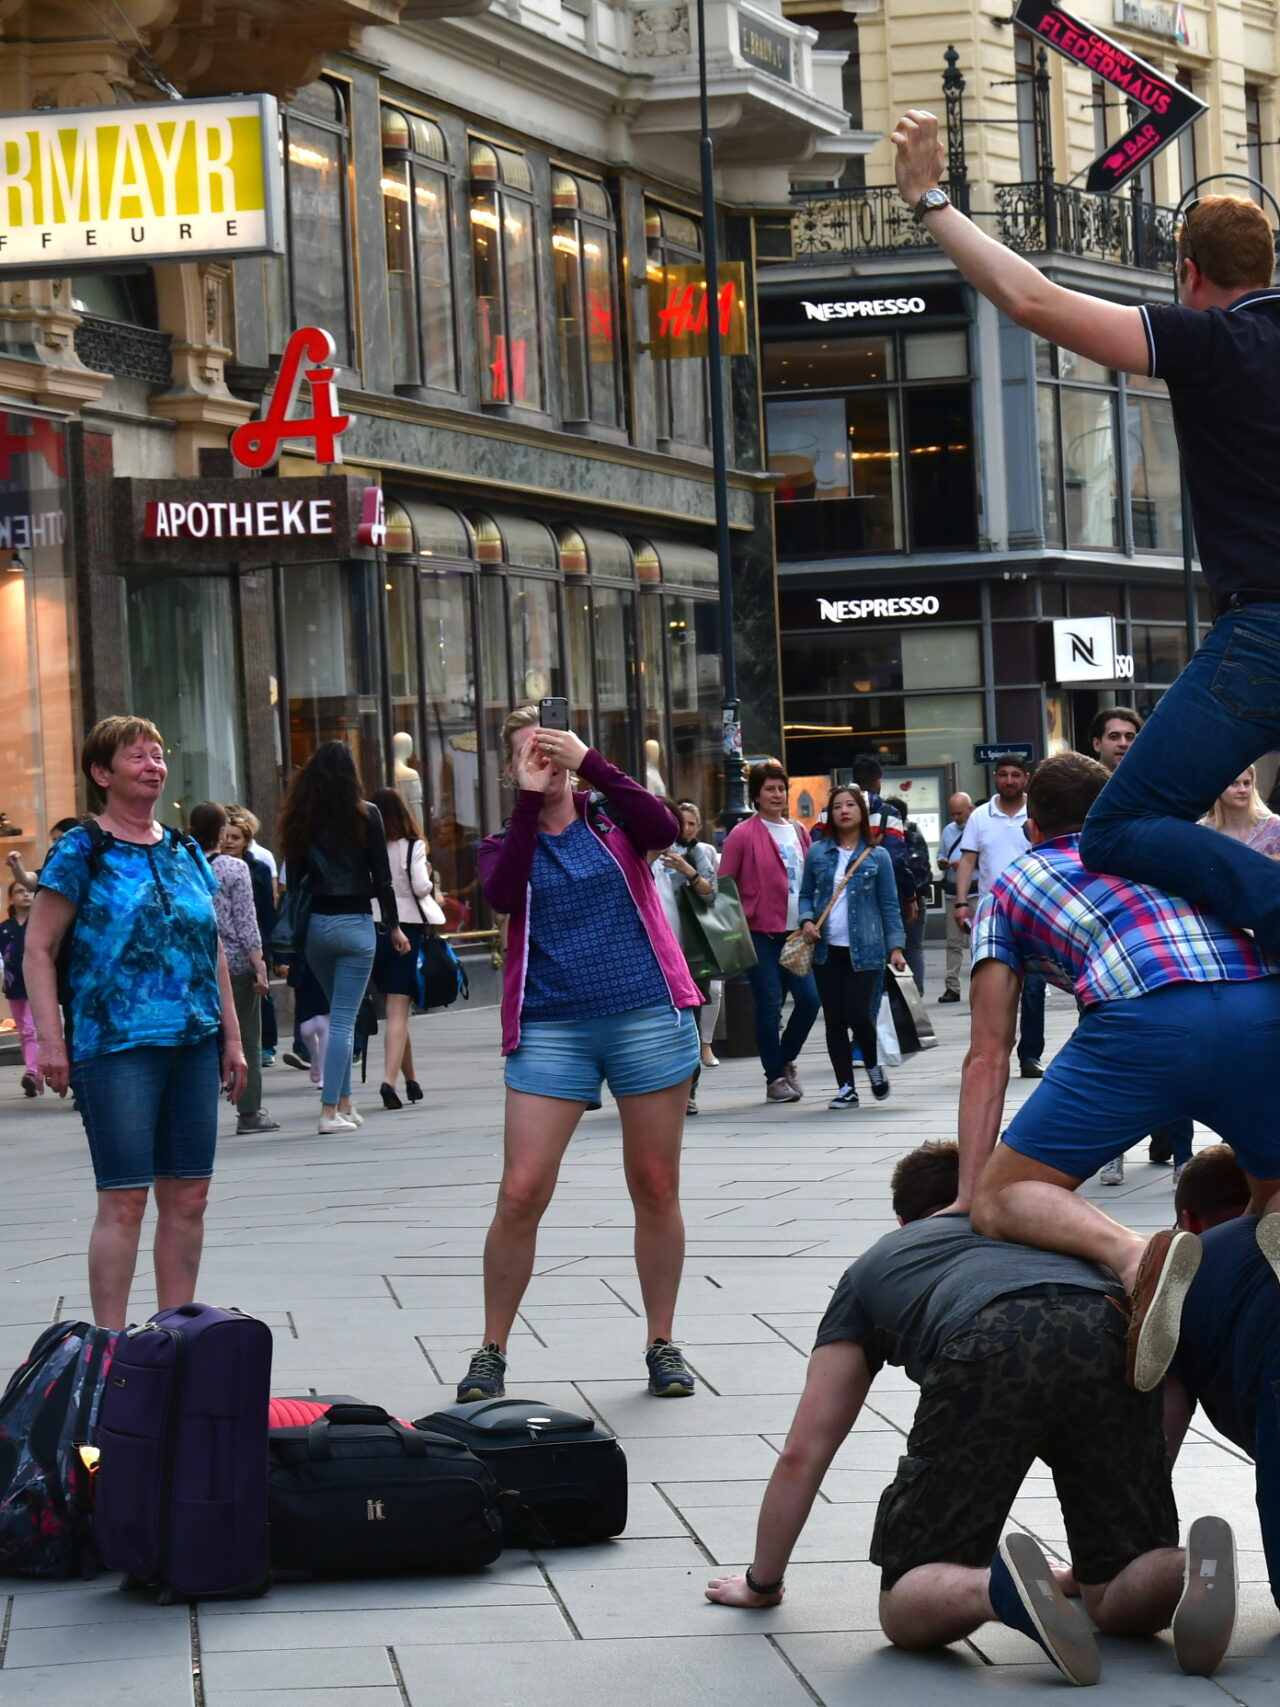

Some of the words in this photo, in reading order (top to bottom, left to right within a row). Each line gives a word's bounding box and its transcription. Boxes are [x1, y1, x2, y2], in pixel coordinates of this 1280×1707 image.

[1036, 14, 1172, 115] FLEDERMAUS
[1088, 34, 1136, 70] CABARET
[1122, 124, 1157, 156] BAR
[0, 120, 236, 226] RMAYR
[800, 297, 926, 321] NESPRESSO
[155, 499, 333, 538] APOTHEKE
[816, 596, 940, 623] NESPRESSO
[367, 1499, 386, 1521] it
